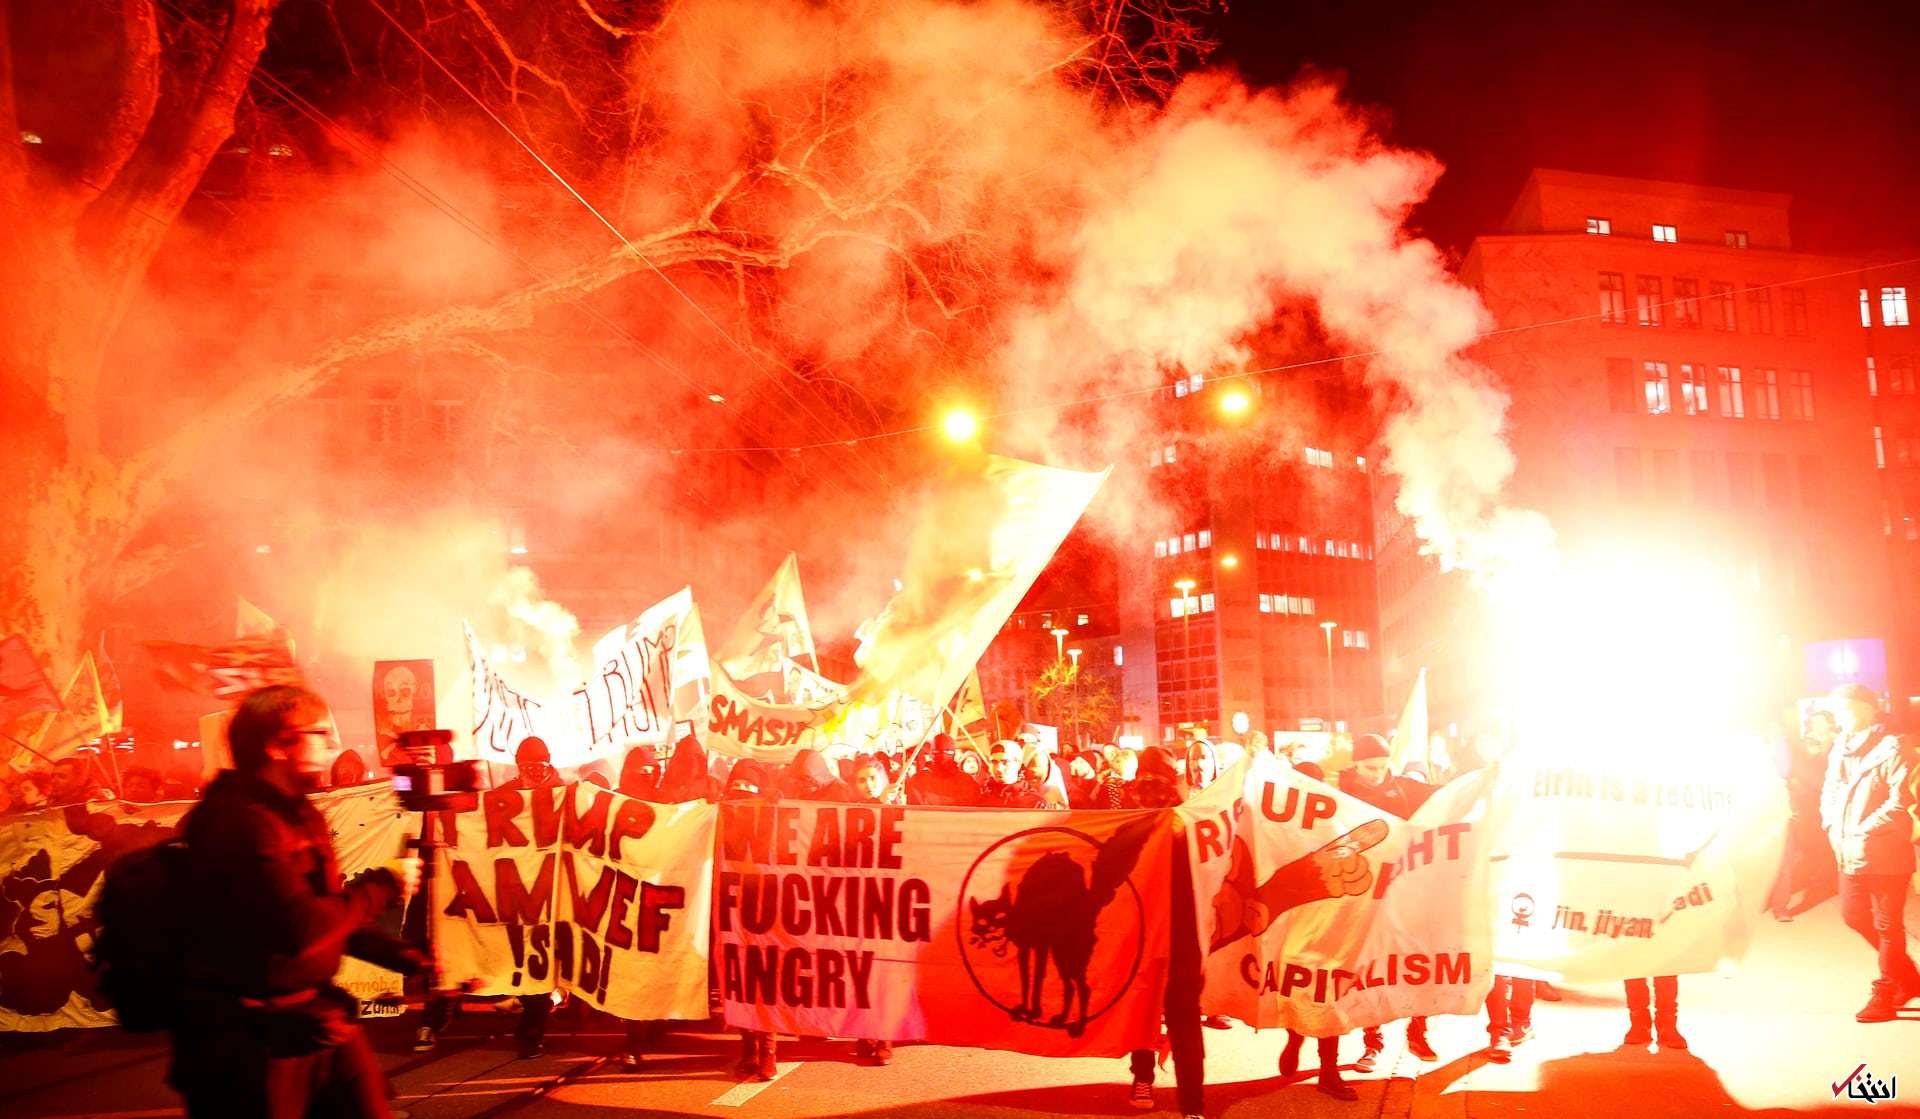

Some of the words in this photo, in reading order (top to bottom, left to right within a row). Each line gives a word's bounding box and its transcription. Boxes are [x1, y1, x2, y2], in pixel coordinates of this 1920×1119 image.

[708, 694, 806, 746] SMASH
[1261, 781, 1337, 830] UP
[719, 804, 801, 866] WE
[807, 807, 905, 870] ARE
[719, 872, 931, 943] FUCKING
[724, 943, 874, 1009] ANGRY
[1240, 952, 1471, 1003] CAPITALISM
